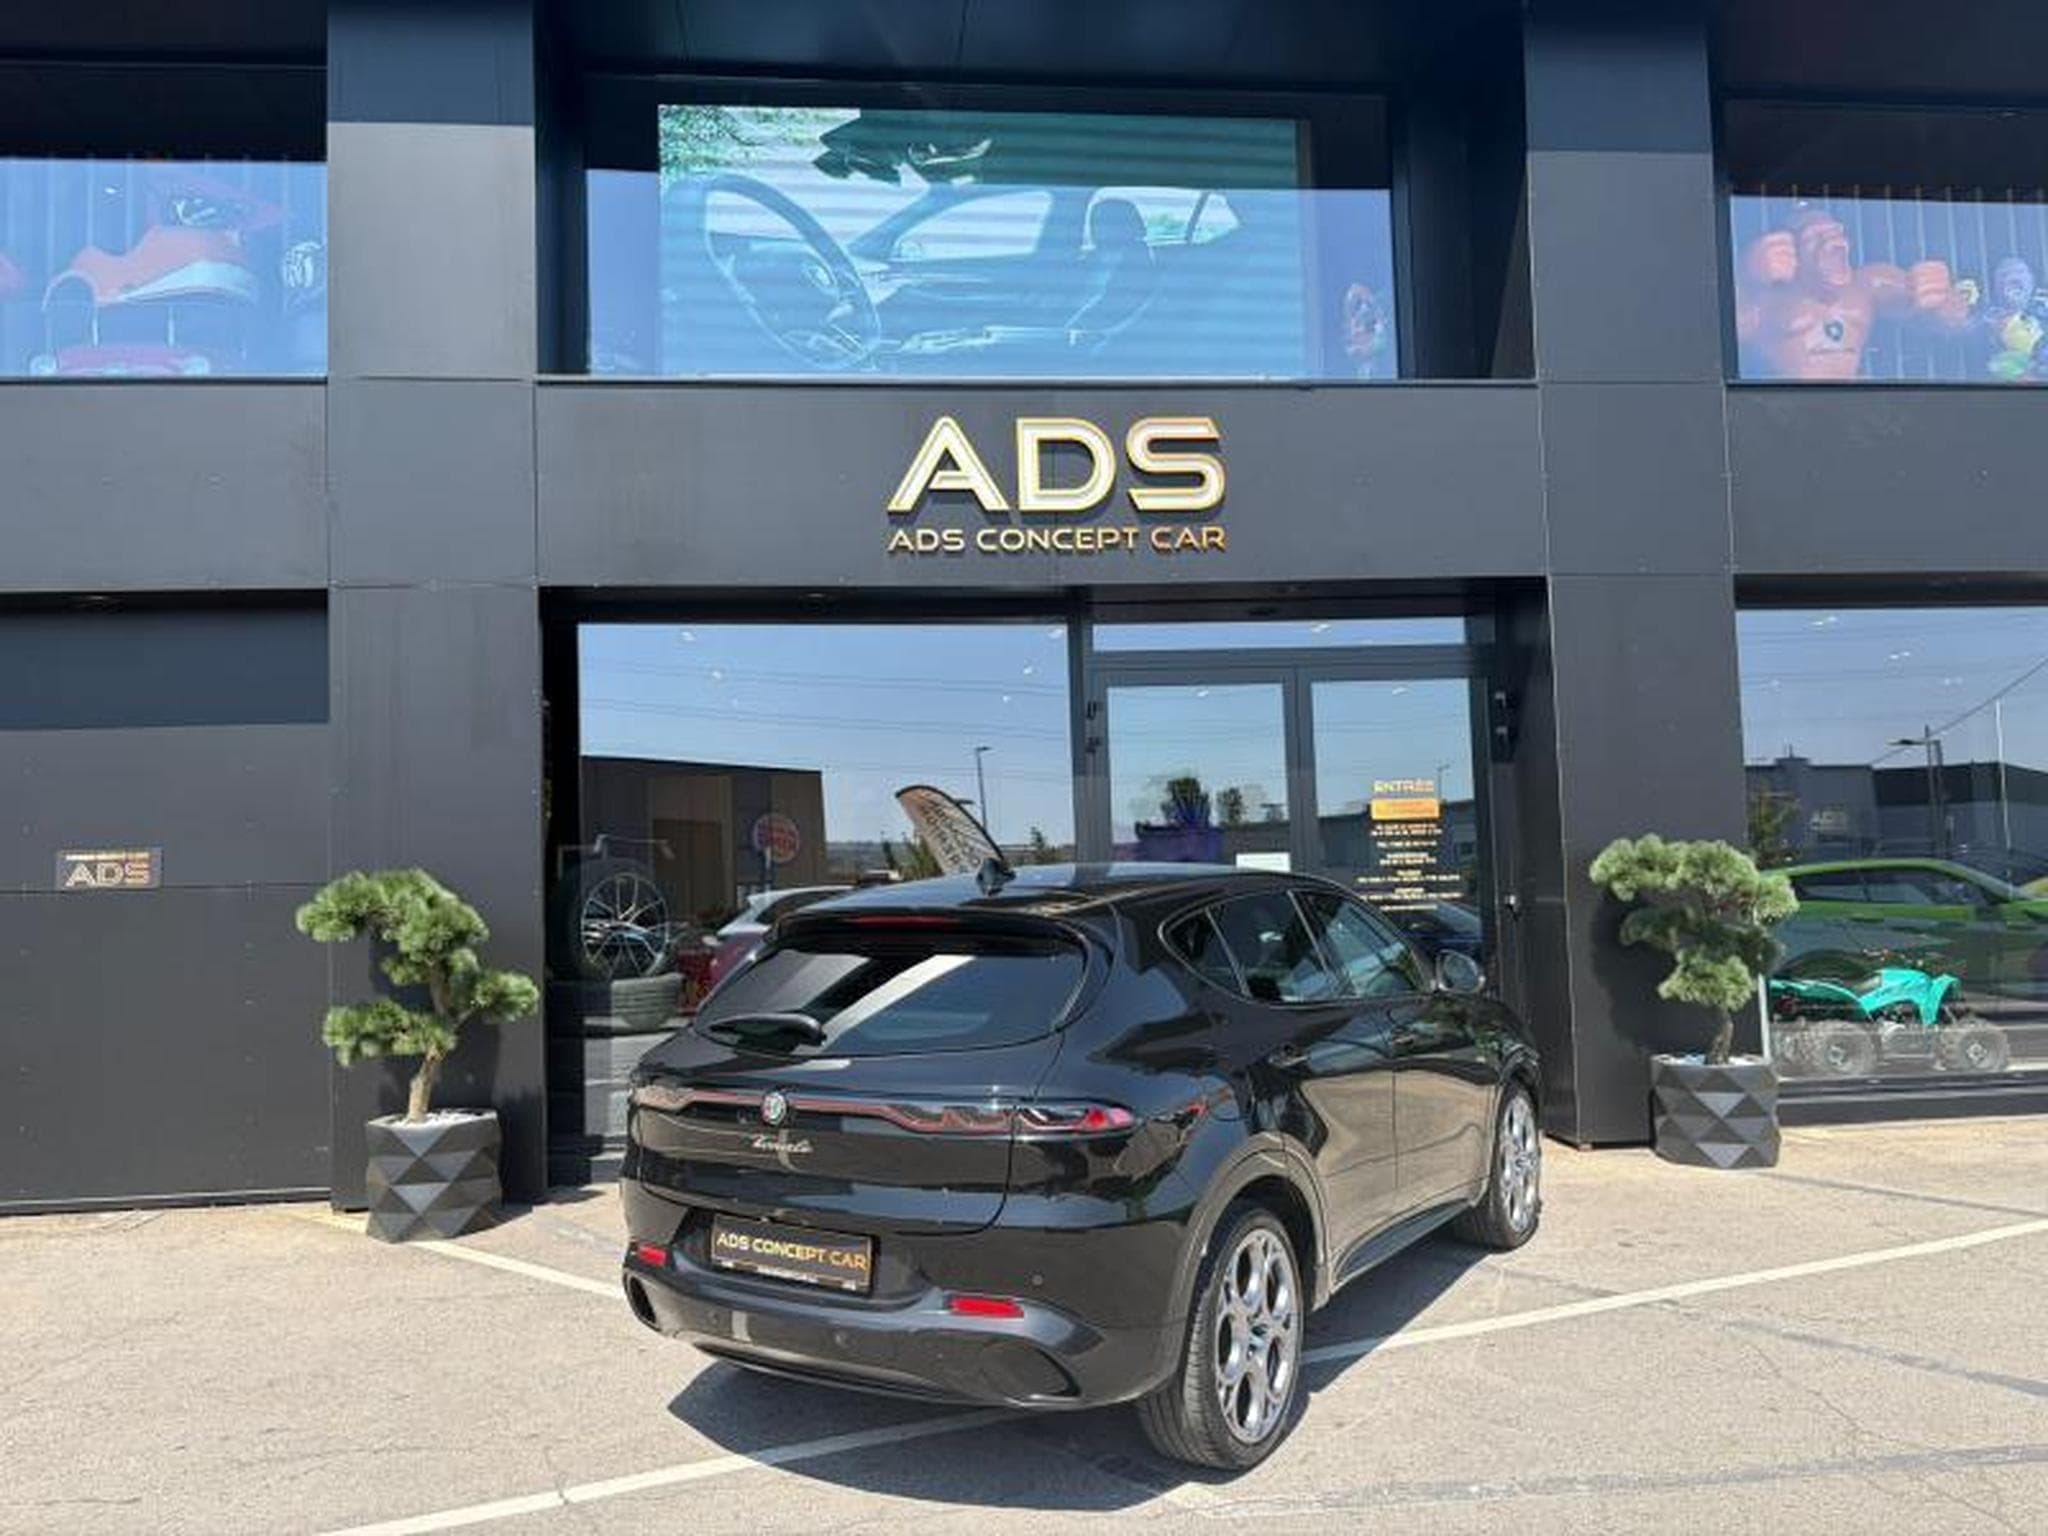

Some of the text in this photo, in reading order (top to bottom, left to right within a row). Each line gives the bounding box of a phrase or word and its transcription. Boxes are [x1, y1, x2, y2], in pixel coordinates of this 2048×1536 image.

[887, 416, 1226, 511] ADS
[888, 526, 1226, 551] ADS CONCEPT CAR
[65, 861, 150, 887] ADS
[716, 1232, 868, 1271] ADS CONCEPT CAR
